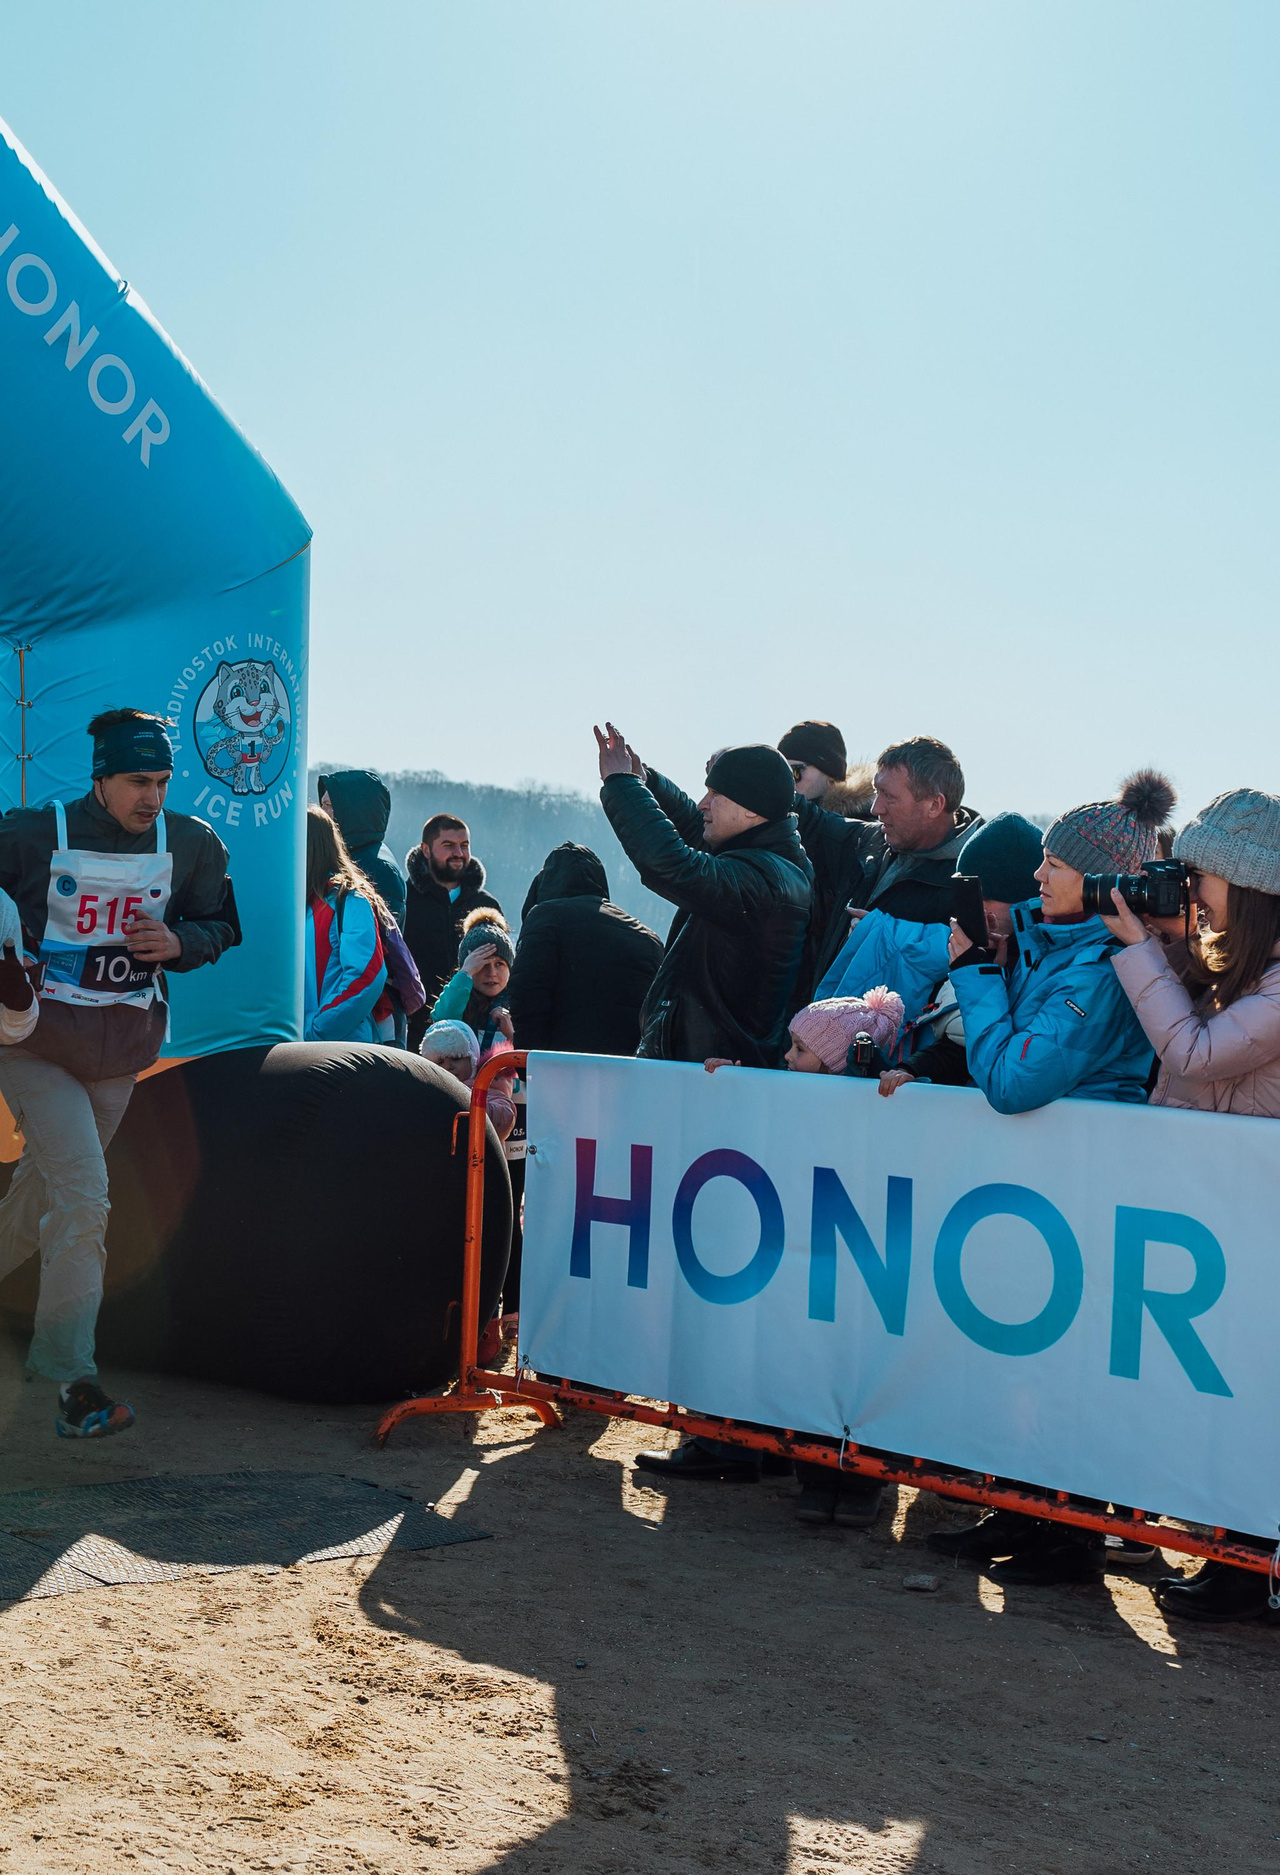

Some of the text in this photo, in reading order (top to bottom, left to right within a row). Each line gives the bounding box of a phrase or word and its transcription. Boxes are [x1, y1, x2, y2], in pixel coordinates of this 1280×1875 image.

[193, 780, 293, 827] ICE RUN
[62, 879, 71, 891] C
[76, 894, 143, 936] 515
[95, 956, 131, 983] 10
[130, 969, 148, 982] km
[570, 1138, 1234, 1398] HONOR
